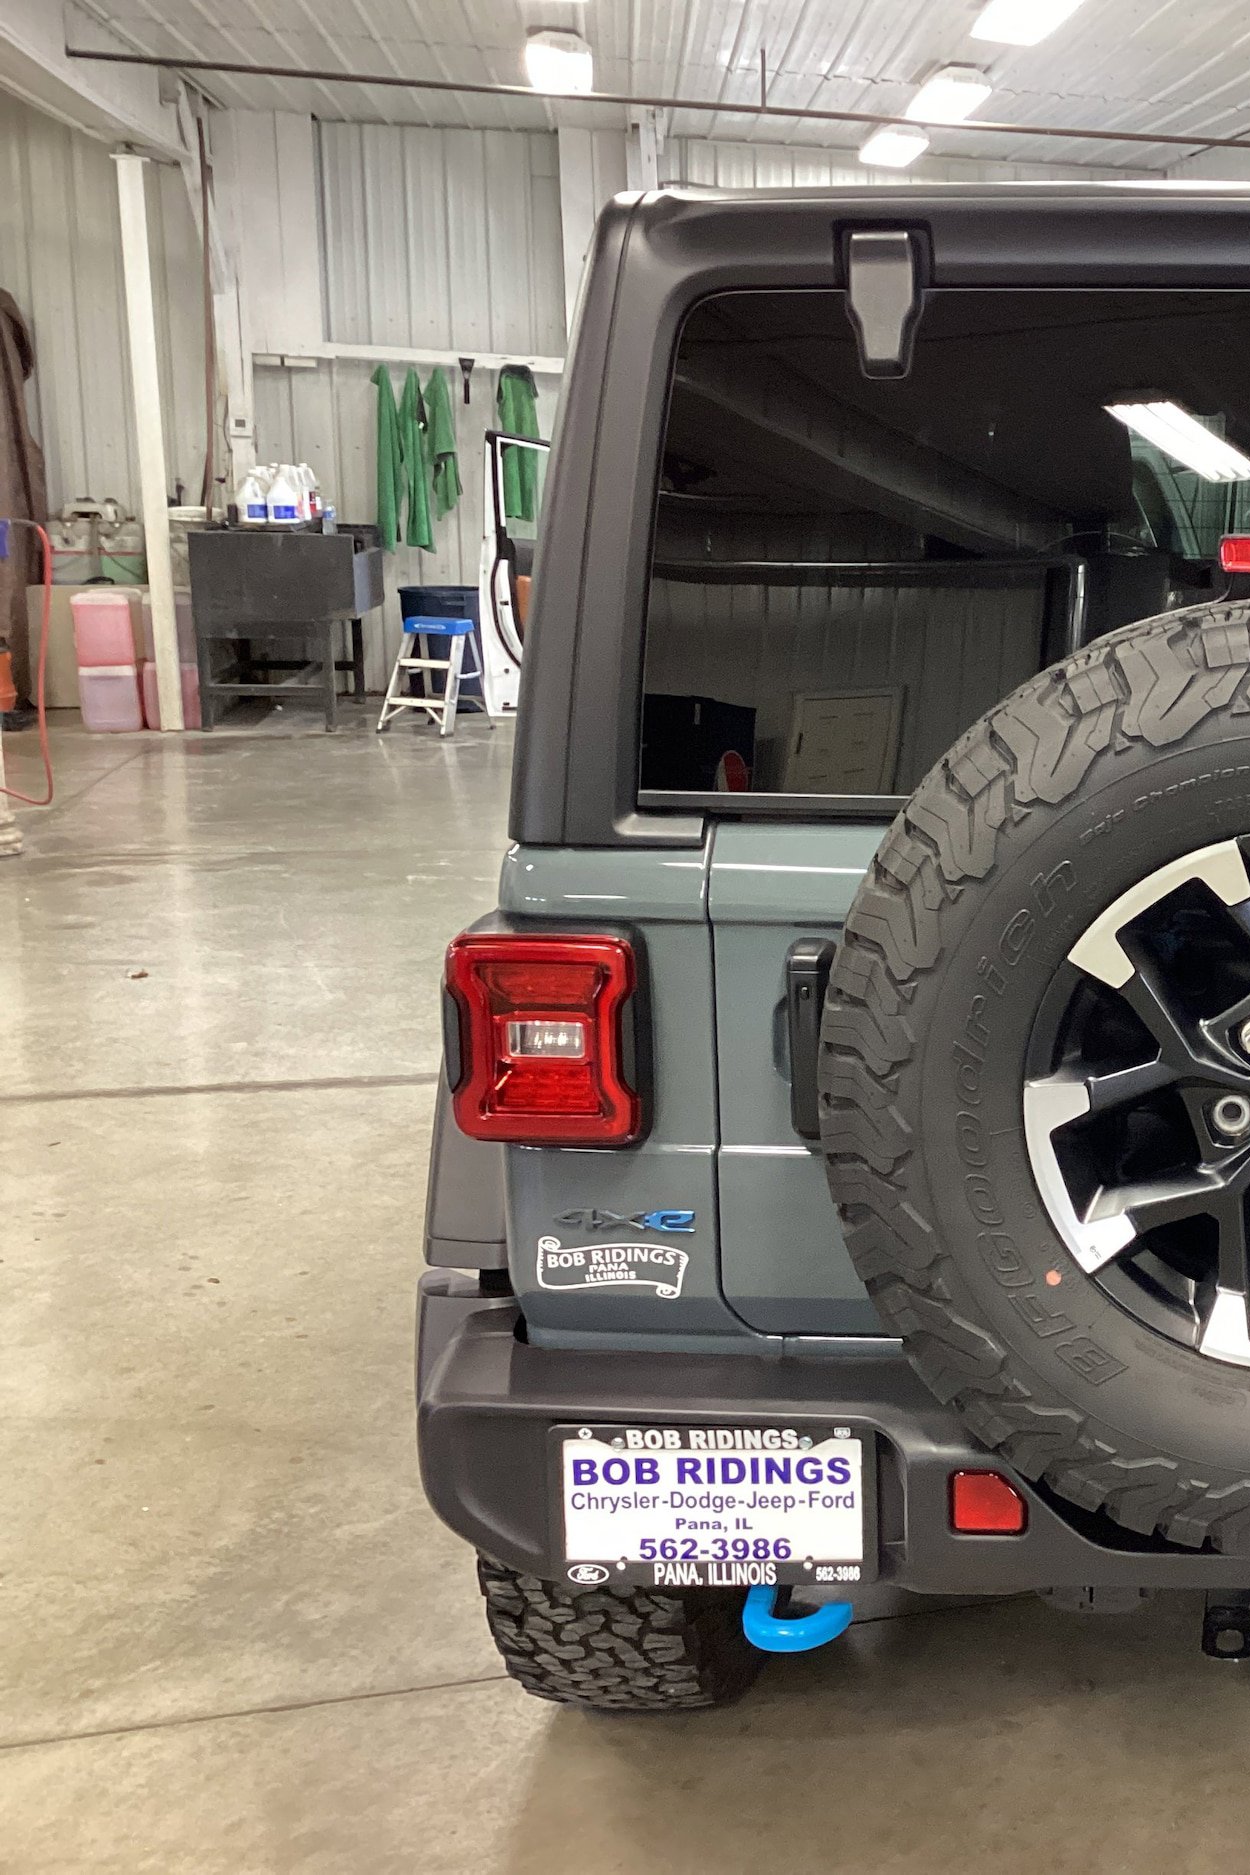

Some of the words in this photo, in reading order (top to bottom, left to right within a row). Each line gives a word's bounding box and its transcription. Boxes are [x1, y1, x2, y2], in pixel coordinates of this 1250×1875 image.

[953, 860, 1129, 1386] BFGoodrich
[546, 1252, 586, 1268] BOB
[591, 1248, 677, 1266] RIDINGS
[589, 1263, 629, 1273] PANA
[585, 1271, 637, 1283] ILLINOIS
[626, 1429, 682, 1450] BOB
[688, 1429, 799, 1450] RIDINGS
[572, 1458, 660, 1486] BOB
[676, 1456, 851, 1486] RIDINGS
[571, 1490, 856, 1514] Chrysler-Dodge-Jeep-Ford
[675, 1517, 729, 1533] Pana,
[735, 1517, 754, 1530] IL
[639, 1537, 792, 1561] 562-3986
[708, 1562, 777, 1585] ILLINOIS
[815, 1565, 861, 1582] 562-3986
